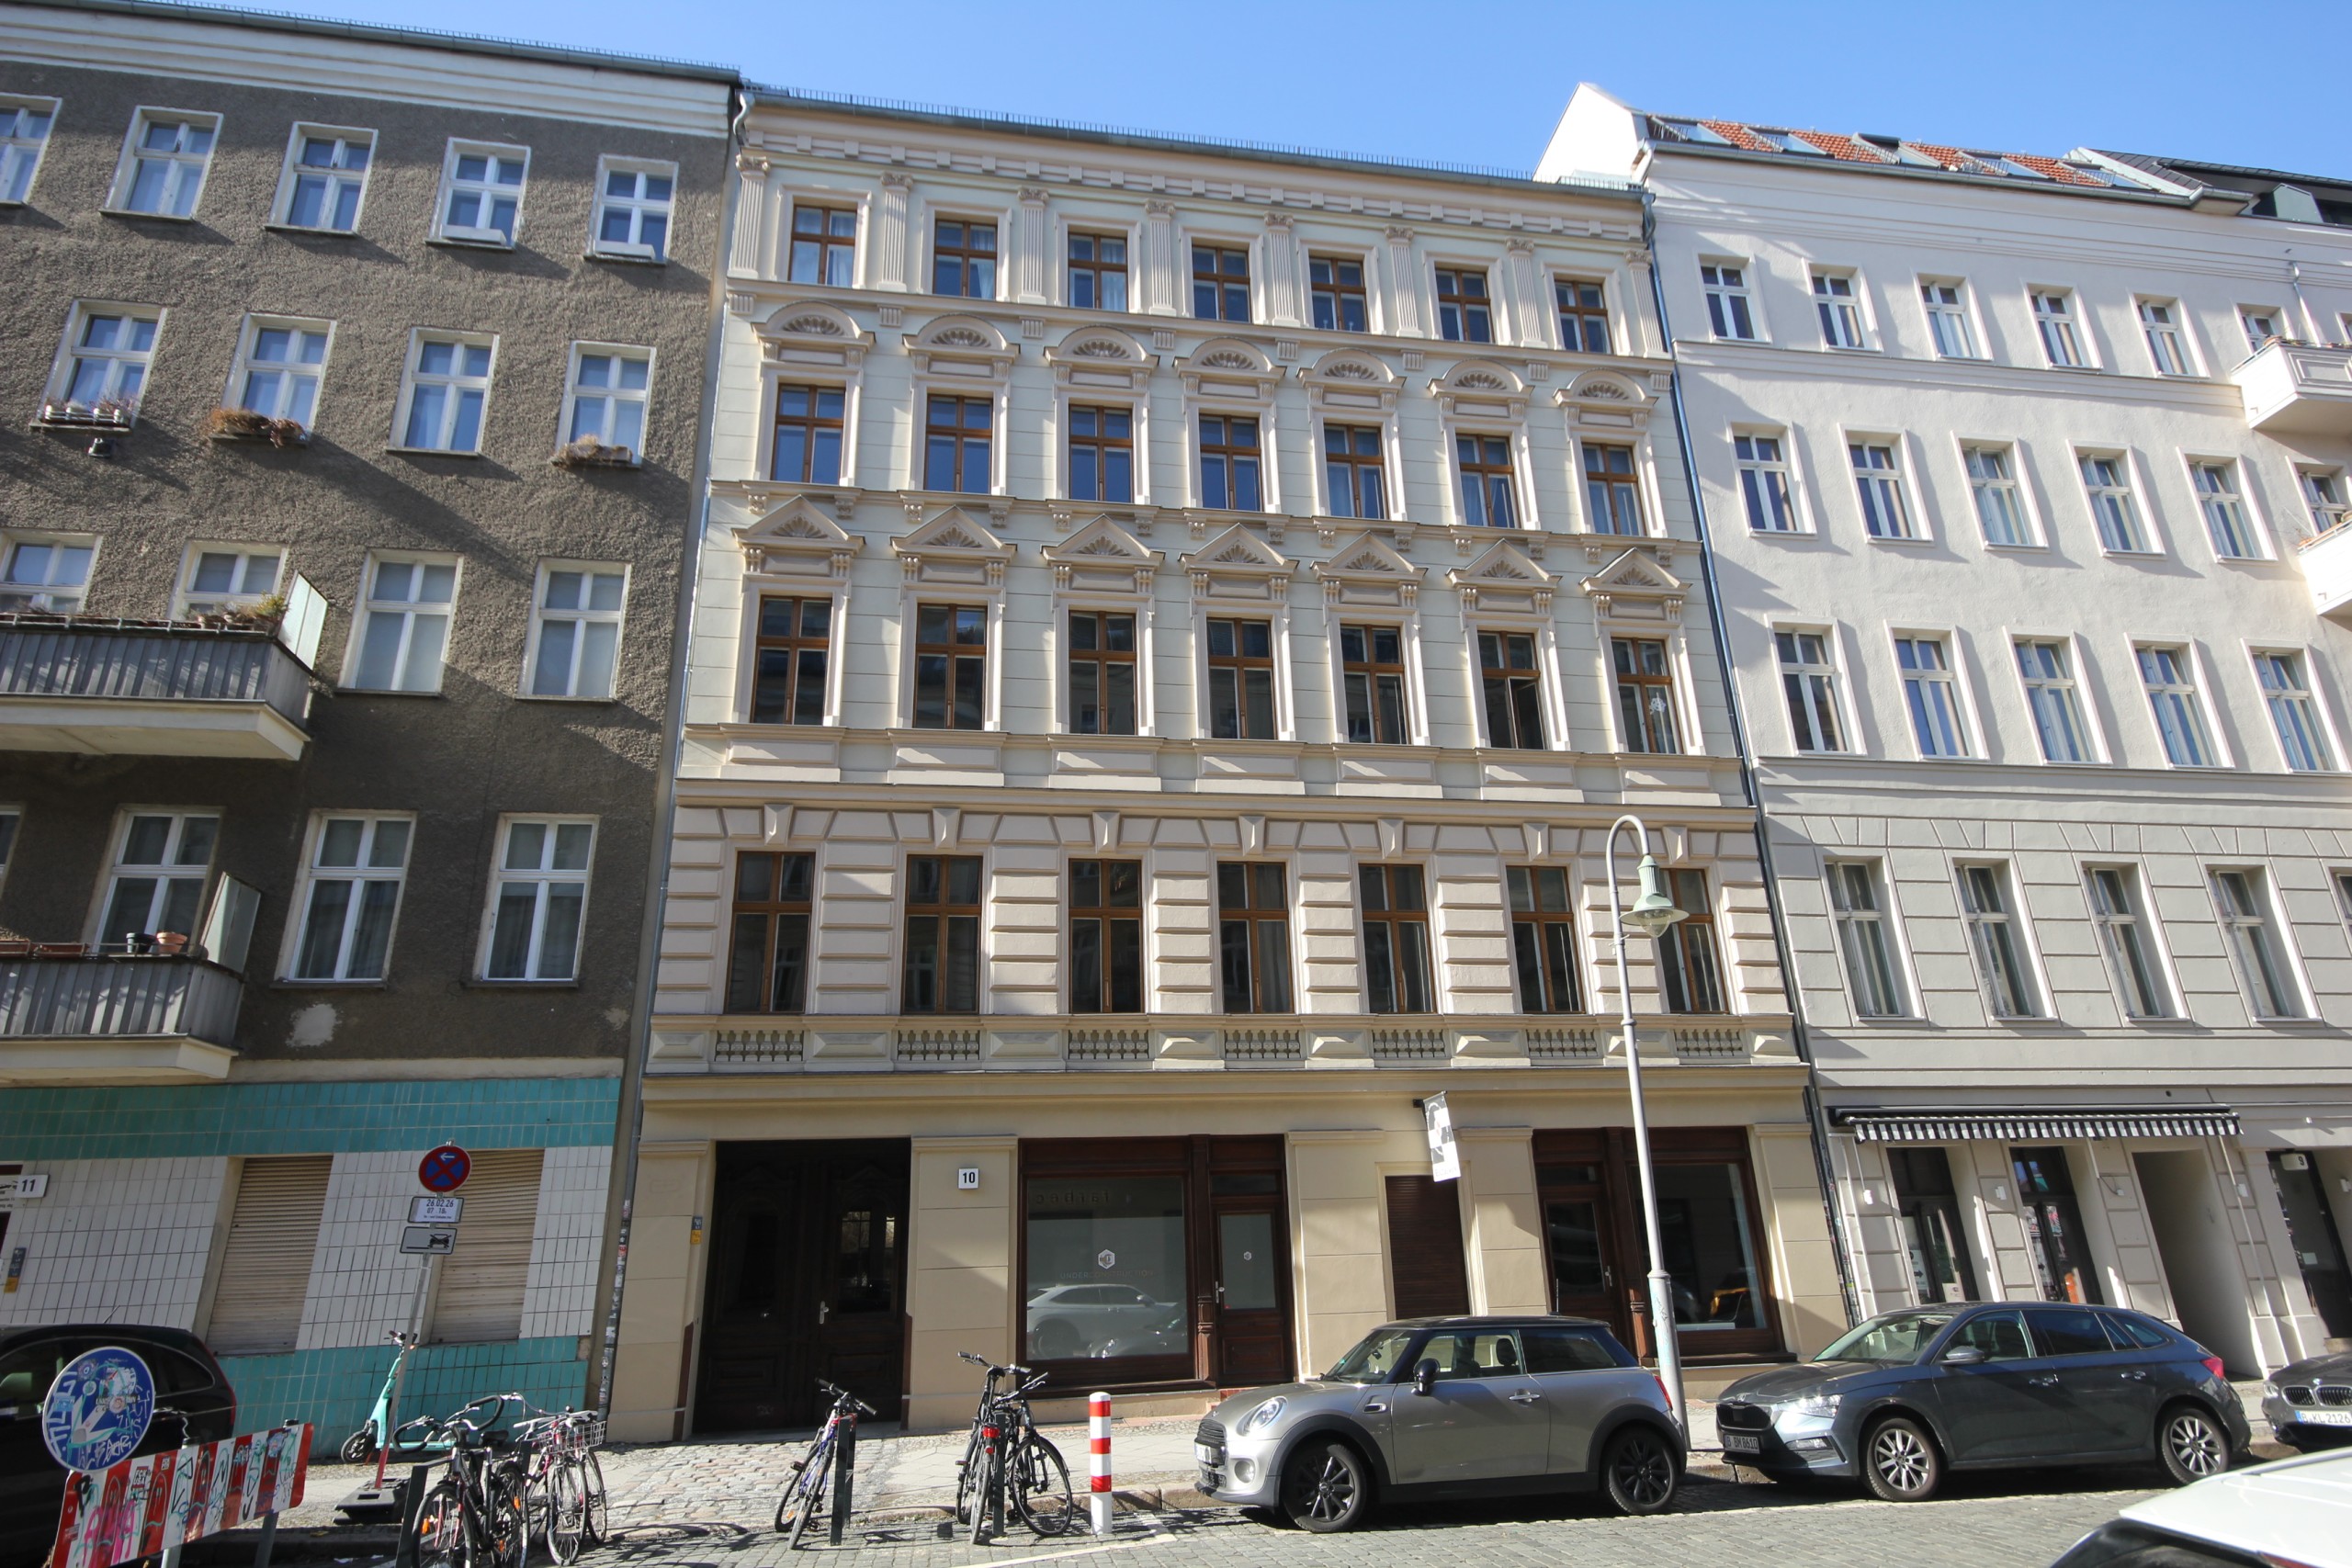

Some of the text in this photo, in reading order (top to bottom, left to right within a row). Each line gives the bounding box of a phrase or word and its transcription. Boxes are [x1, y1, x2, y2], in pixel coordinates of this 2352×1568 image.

[2298, 1156, 2305, 1167] 9
[962, 1171, 976, 1184] 10
[21, 1179, 37, 1192] 11
[425, 1199, 455, 1208] 26.02.26
[2325, 1413, 2351, 1424] 2126
